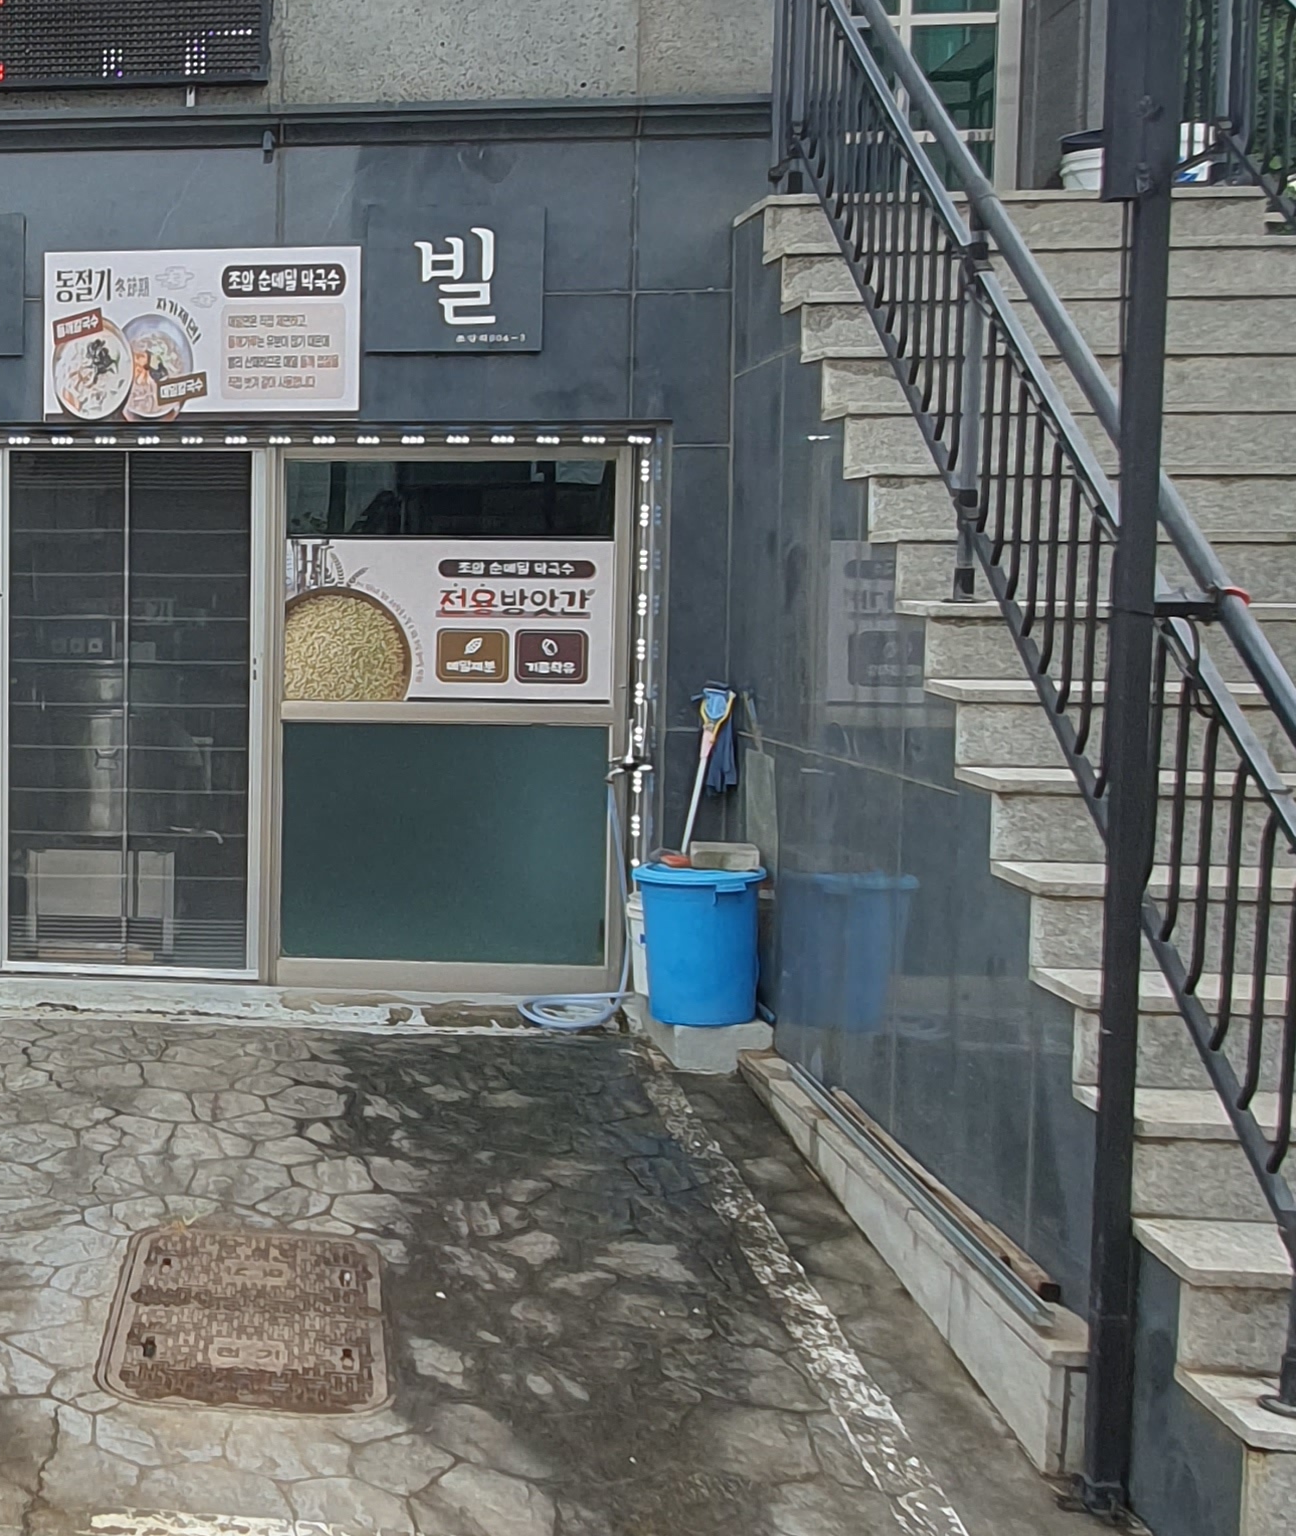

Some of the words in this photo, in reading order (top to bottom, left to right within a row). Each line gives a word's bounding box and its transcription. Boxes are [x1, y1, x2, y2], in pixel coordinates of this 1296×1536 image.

[55, 268, 112, 302] 동절기
[228, 269, 255, 292] 조암
[258, 268, 297, 292] 순메밀
[301, 268, 341, 292] 막국수
[413, 227, 496, 325] 빌
[439, 587, 590, 616] 전용방앗간
